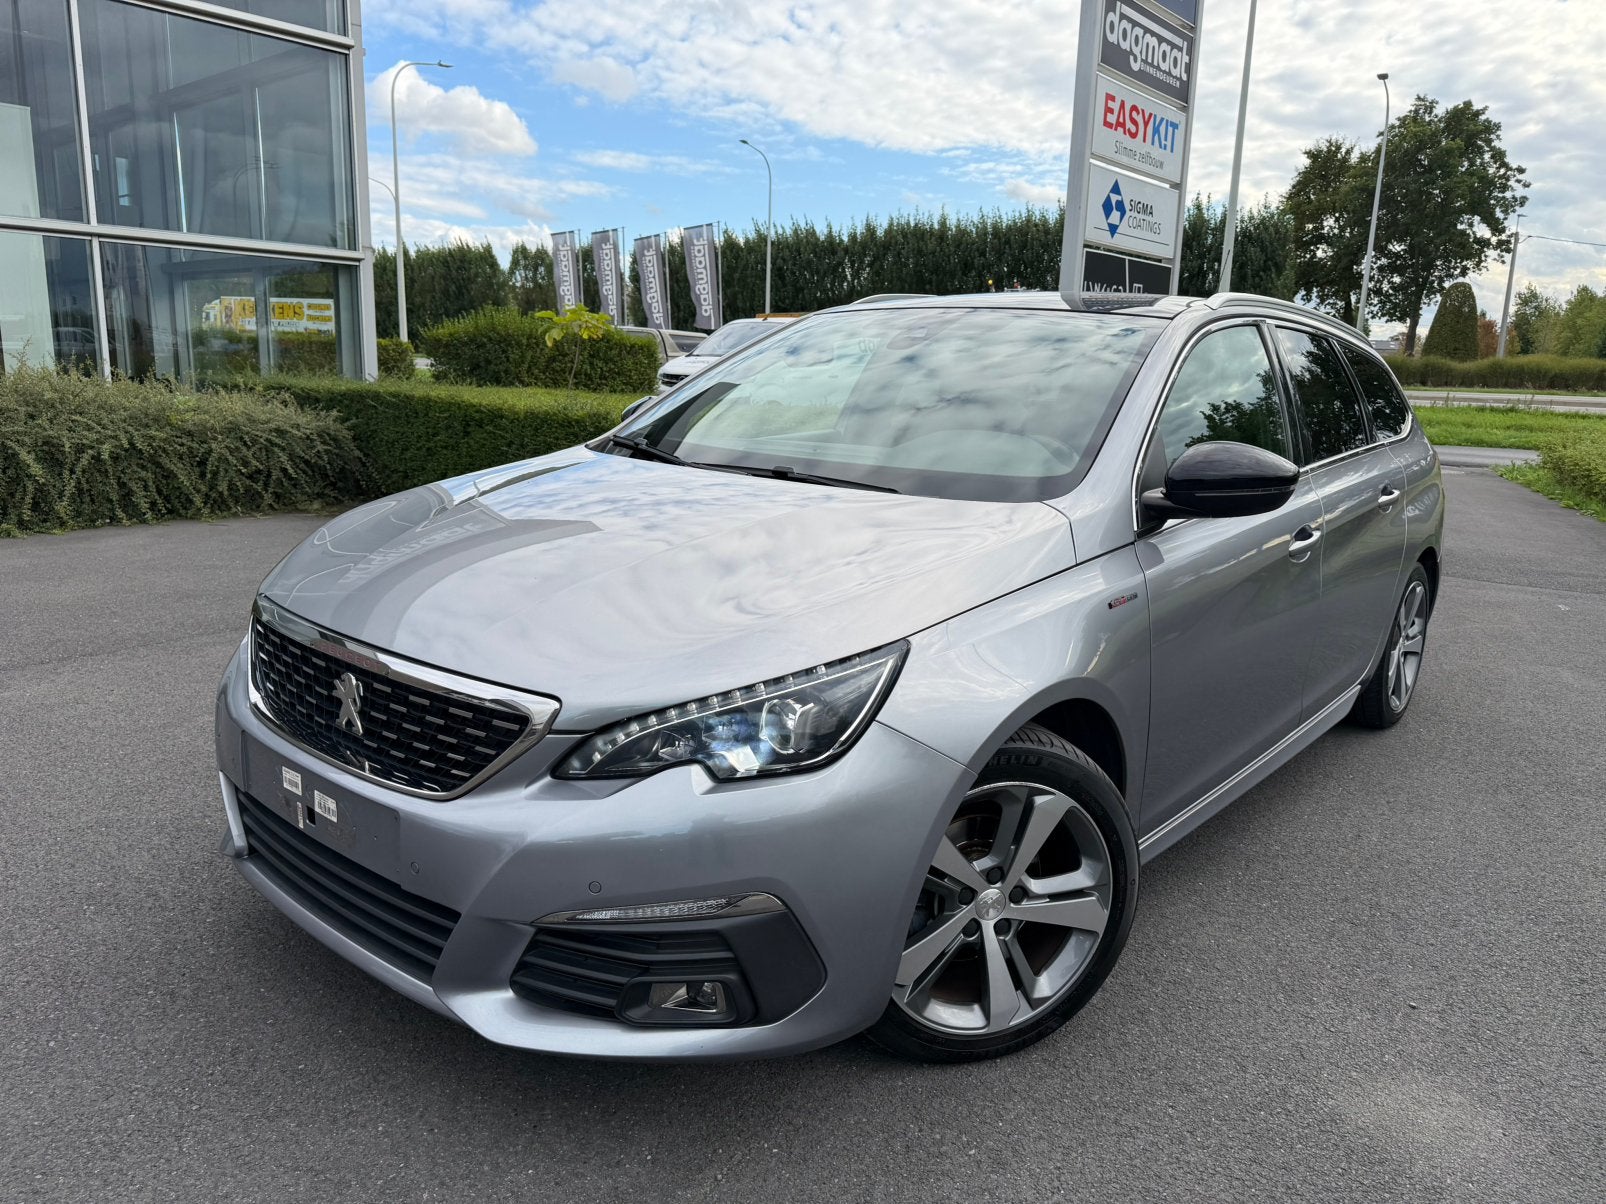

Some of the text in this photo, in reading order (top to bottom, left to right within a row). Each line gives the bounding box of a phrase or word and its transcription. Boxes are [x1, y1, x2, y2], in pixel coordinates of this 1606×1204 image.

[1105, 1, 1189, 81] dagmaat
[1114, 140, 1137, 161] Slimme
[1128, 199, 1154, 217] SIGMA
[1127, 215, 1162, 235] COATINGS
[319, 642, 382, 672] PEUGEOT
